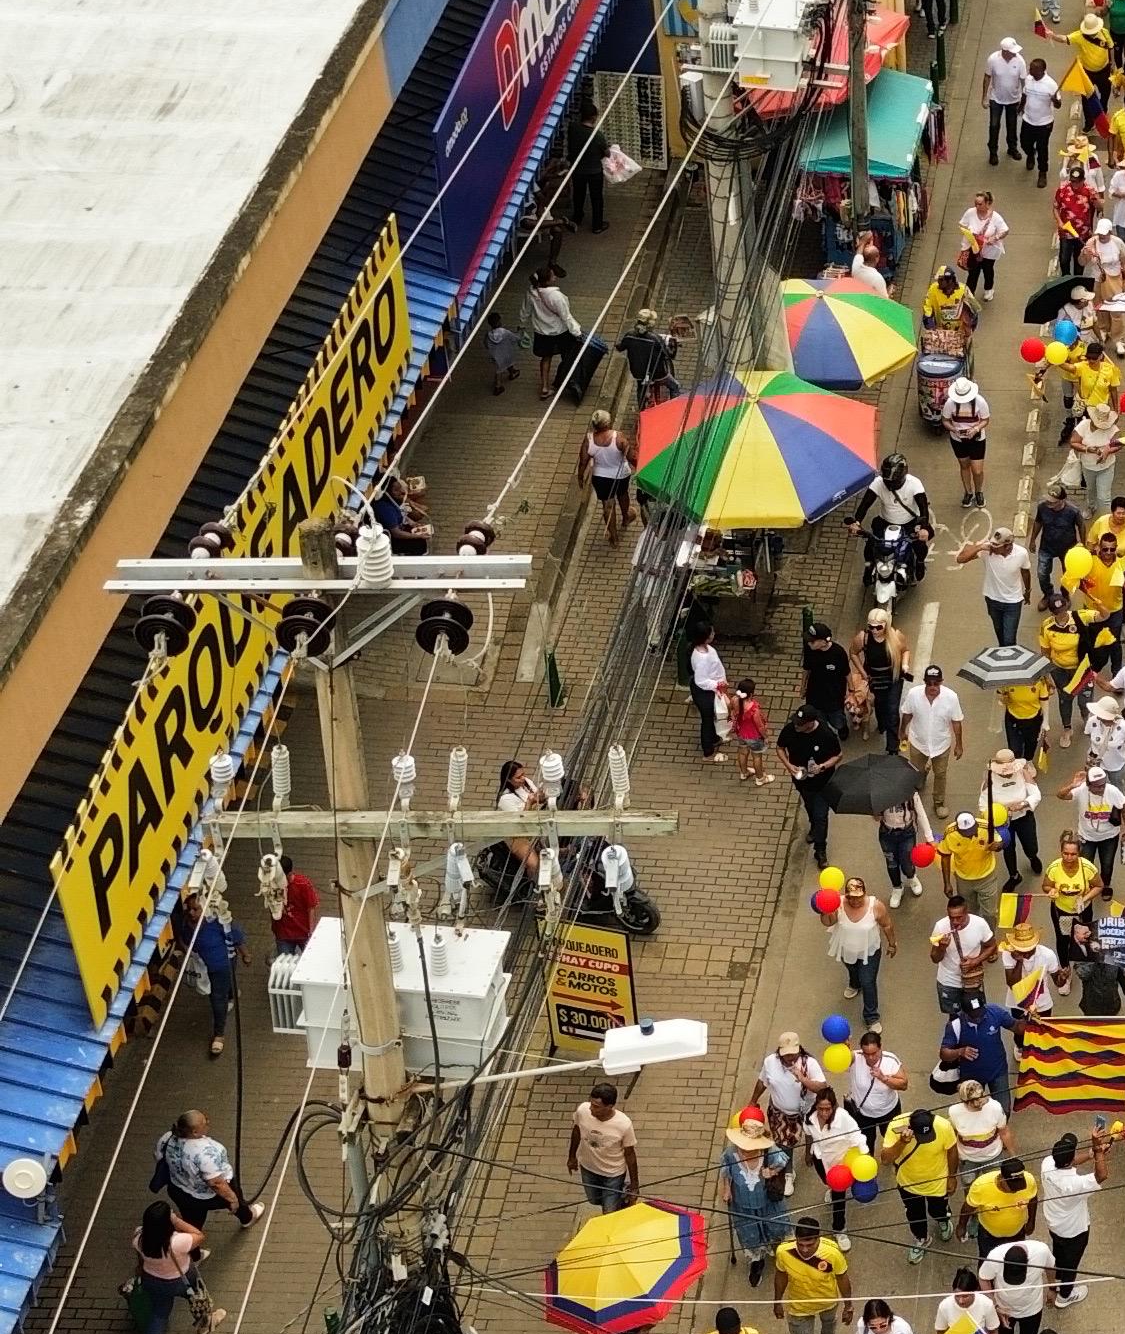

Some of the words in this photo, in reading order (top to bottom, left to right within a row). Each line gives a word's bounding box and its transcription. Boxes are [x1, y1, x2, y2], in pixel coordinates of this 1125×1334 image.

[541, 21, 568, 79] ESTAMOS
[561, 954, 587, 967] HAY
[588, 959, 620, 973] CUPO
[556, 968, 616, 987] CARROS
[556, 978, 567, 987] &
[568, 979, 618, 997] MOTOS
[559, 1008, 568, 1023] $
